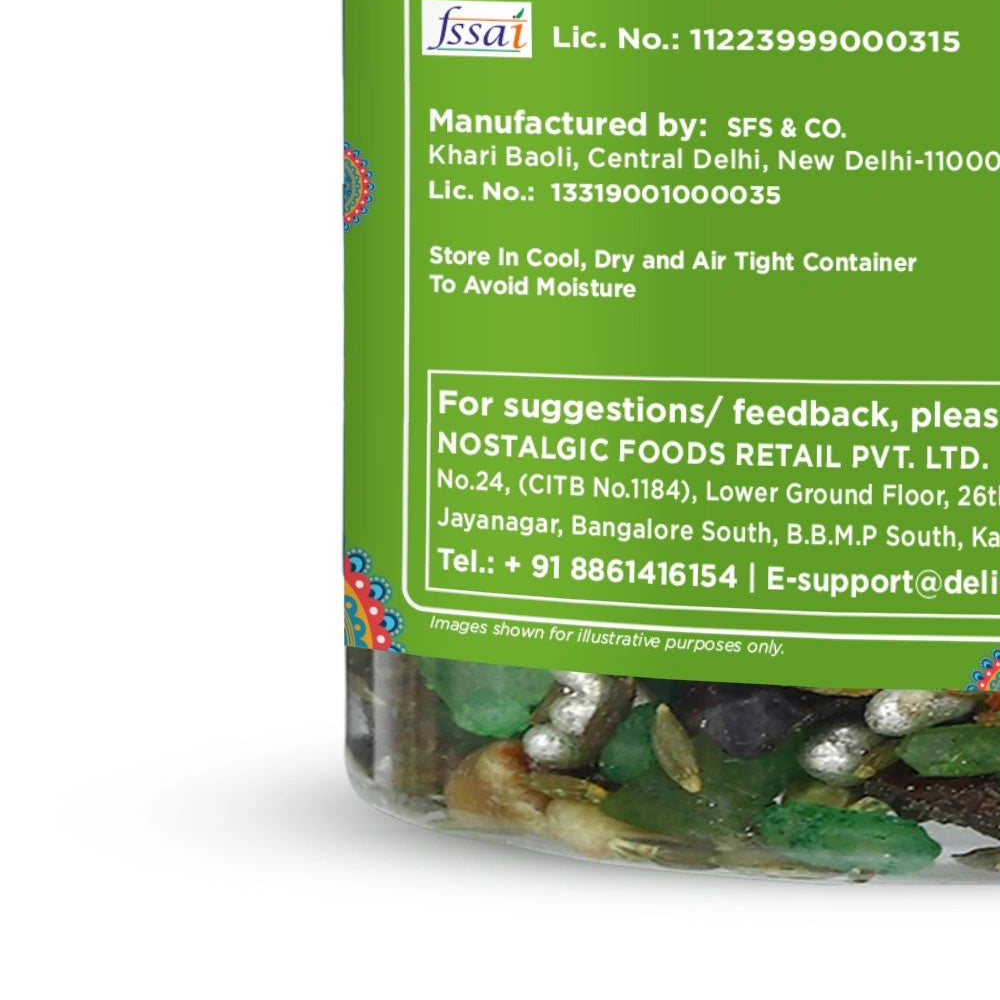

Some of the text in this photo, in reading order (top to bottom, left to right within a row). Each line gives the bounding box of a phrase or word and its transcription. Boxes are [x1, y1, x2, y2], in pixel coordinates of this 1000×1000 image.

[427, 5, 527, 52] fssai
[553, 25, 960, 52] Lic. No.: 11223999000315
[430, 108, 846, 141] Manufactured by: SFS & CO.
[429, 144, 496, 165] Khari
[506, 146, 578, 170] Baoli,
[588, 147, 682, 169] Central
[694, 149, 768, 173] Delhi,
[779, 150, 834, 170] New
[429, 180, 780, 204] Lic. No.: 13319001000035
[430, 246, 917, 274] Store In Cool, Dry and Air Tight Container
[429, 274, 636, 298] To Avoid Moisture
[439, 390, 493, 416] For
[504, 396, 723, 428] suggestions/
[733, 398, 898, 432] feedback,
[437, 548, 494, 574] Tel.:
[505, 556, 521, 572] +
[532, 554, 559, 579] 91
[571, 556, 737, 588] 8861416154
[431, 616, 783, 656] Images shown for illustrative purposes only.
